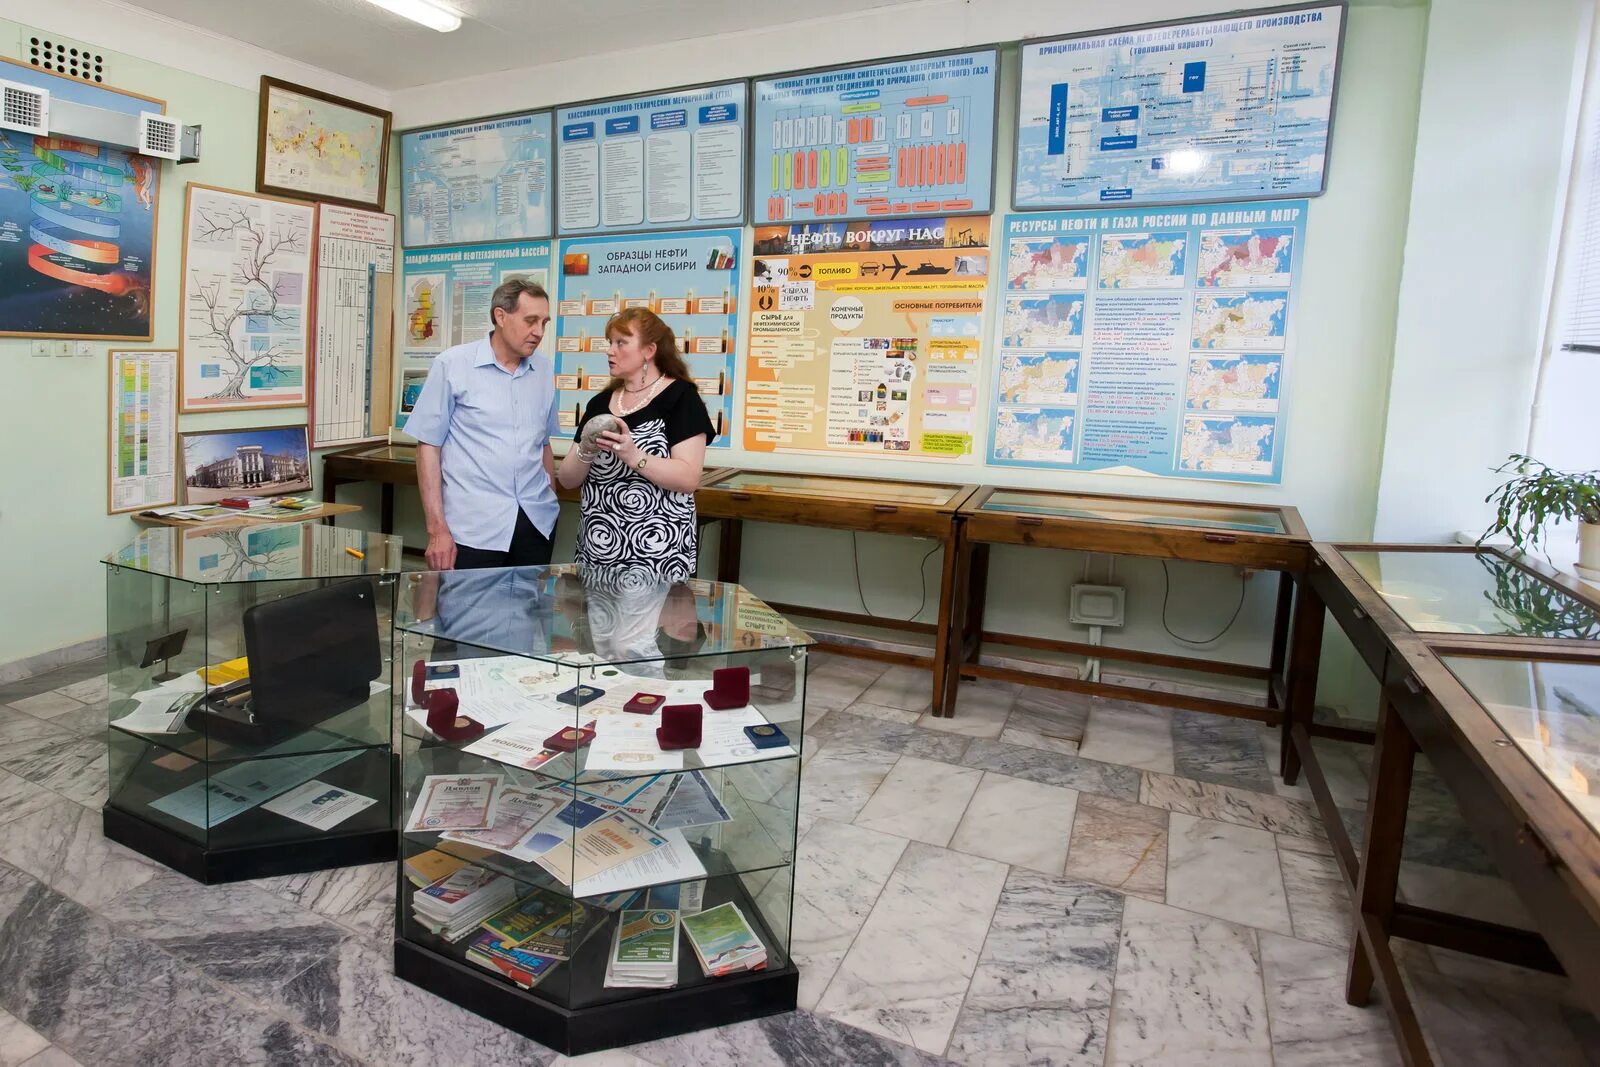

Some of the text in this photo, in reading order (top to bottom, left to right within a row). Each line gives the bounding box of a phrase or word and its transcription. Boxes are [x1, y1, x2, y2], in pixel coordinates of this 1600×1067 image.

[1039, 40, 1106, 56] ПРИНЦИПИАЛЬНАЯ
[1108, 36, 1134, 47] СХЕМА
[1256, 12, 1322, 29] ПРОИЗВОДСТВА
[774, 78, 804, 90] ОСНОВНЫЕ
[806, 76, 820, 86] ПУТИ
[822, 72, 856, 84] ПОЛУЧЕНИЯ
[858, 66, 908, 80] СИНТЕТИЧЕСКИХ
[792, 84, 834, 98] ОРГАНИЧЕСКИХ
[836, 79, 874, 92] СОЕДИНЕНИЙ
[876, 78, 884, 88] ИЗ
[887, 72, 926, 86] ПРИРОДНОГО
[972, 66, 988, 76] ГАЗА
[1010, 208, 1300, 232] РЕСУРСЫ НЕФТИ И ГАЗА РОССИИ ПО ДАННЫМ МПР
[790, 226, 944, 246] НЕФТЬ ВОКРУГ НАС
[606, 248, 688, 262] ОБРАЗЦЫ НЕФТИ
[598, 261, 696, 274] ЗАПАДНОЙ СИБИРИ
[778, 266, 798, 277] 90%
[818, 267, 851, 276] ТОПЛИВО
[757, 284, 775, 294] 10%
[491, 738, 534, 752] ДИПЛОМ
[510, 798, 544, 808] Диплом
